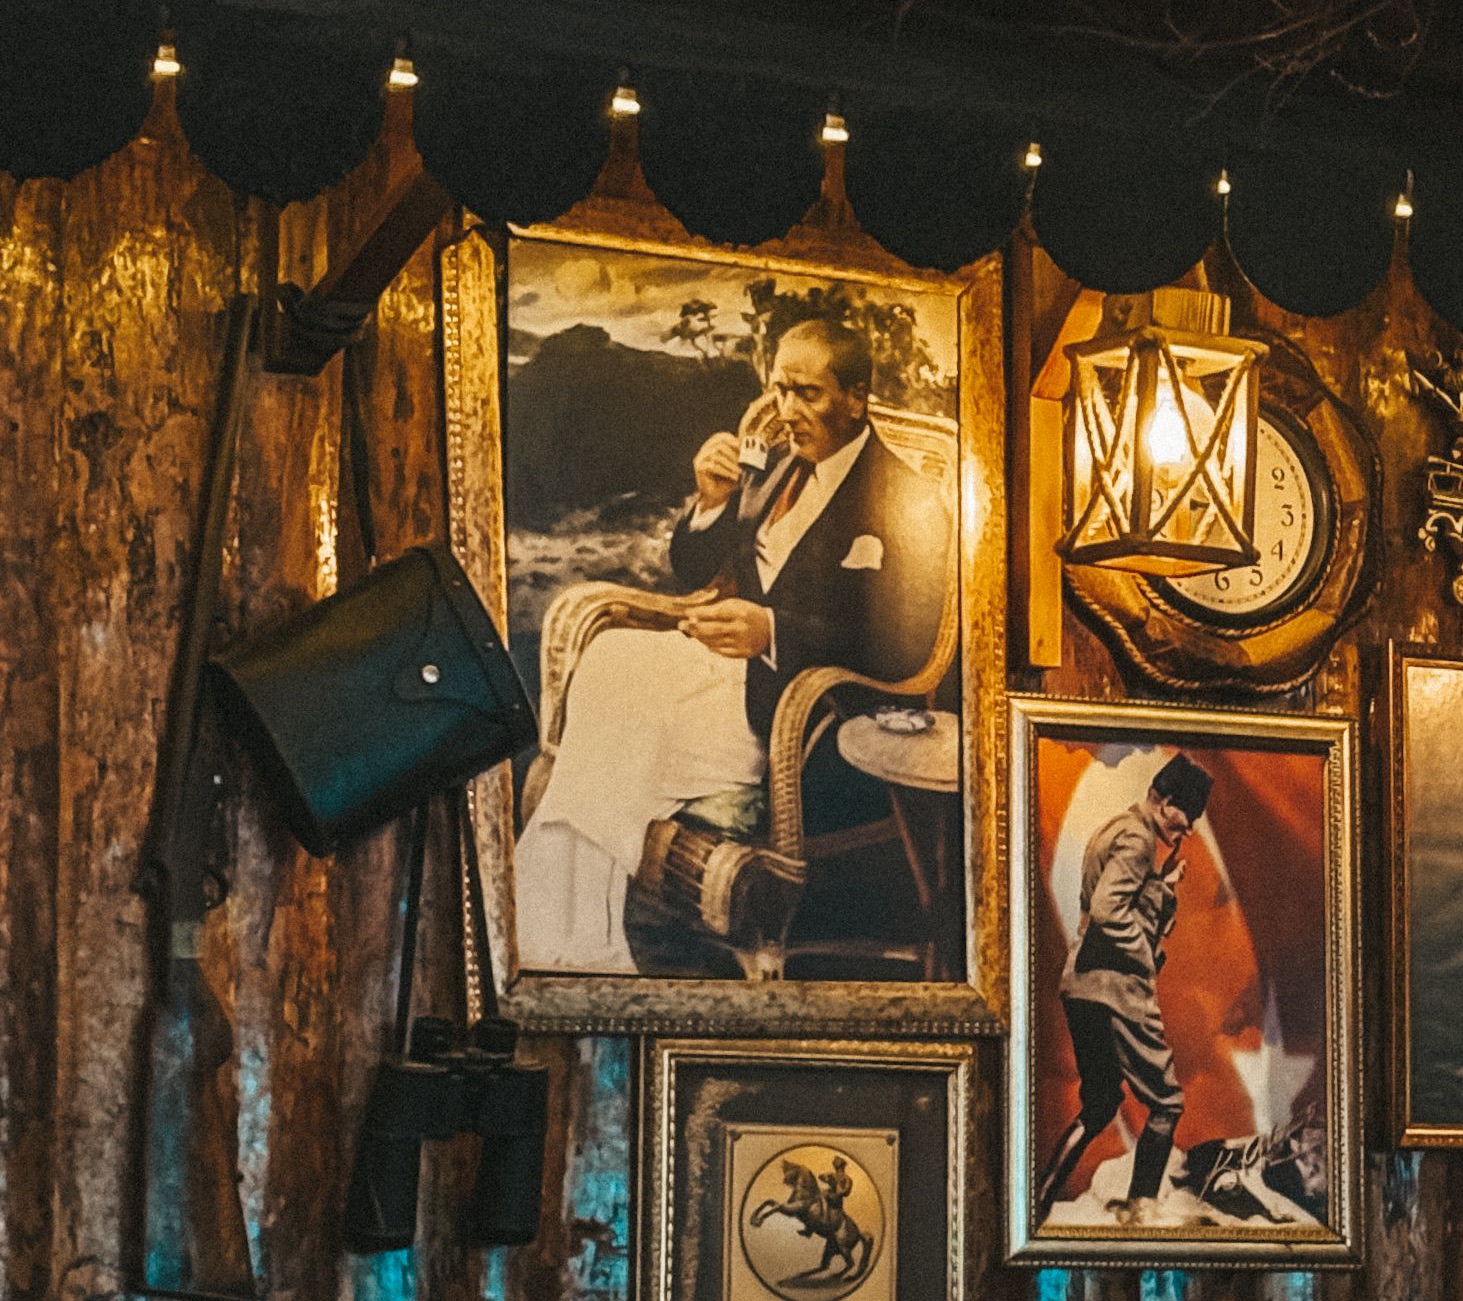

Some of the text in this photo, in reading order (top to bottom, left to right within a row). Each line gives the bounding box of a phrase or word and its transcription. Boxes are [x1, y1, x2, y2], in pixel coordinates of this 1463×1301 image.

[1272, 467, 1285, 490] 2
[1281, 504, 1294, 527] 3
[1271, 539, 1284, 561] 4
[1214, 570, 1231, 592] 6
[1250, 564, 1263, 586] 5
